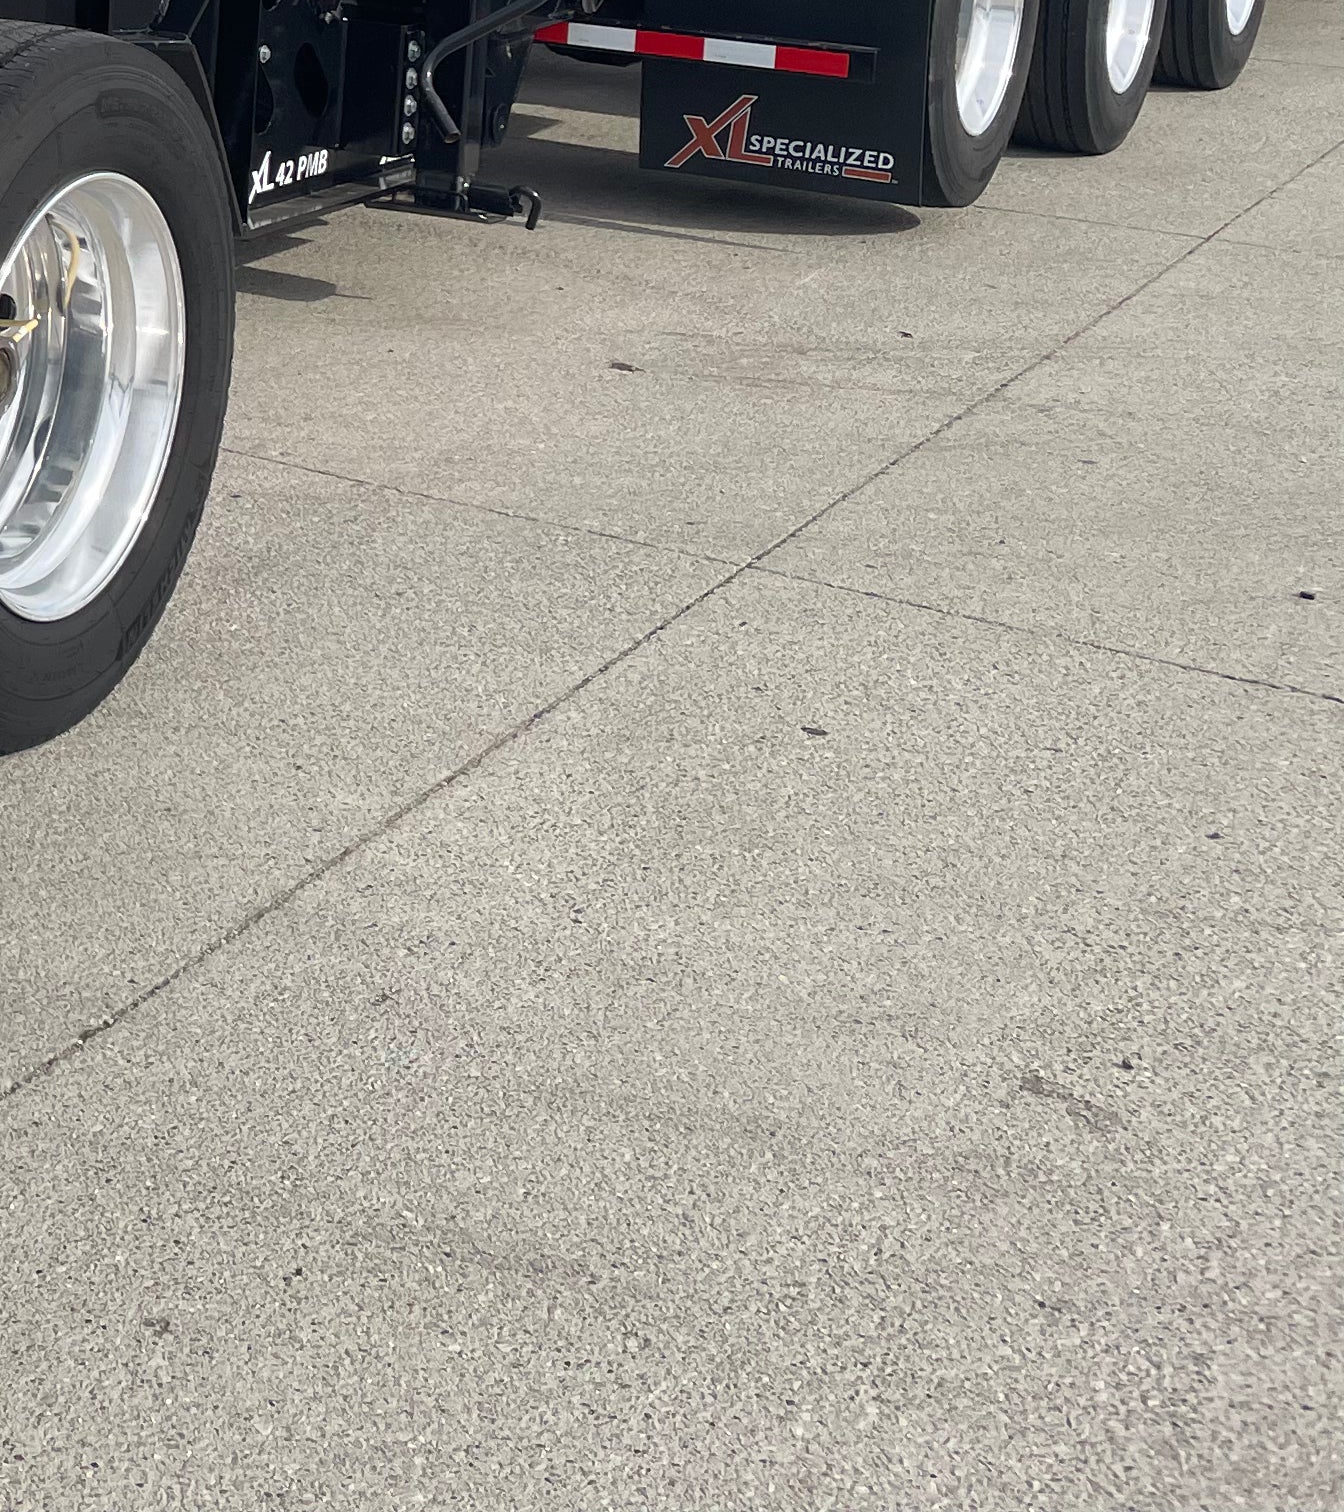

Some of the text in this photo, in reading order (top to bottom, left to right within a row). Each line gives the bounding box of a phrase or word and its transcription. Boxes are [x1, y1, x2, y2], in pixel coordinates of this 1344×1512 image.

[664, 94, 895, 170] XL SPECIALIZED
[248, 149, 329, 205] XL 42 PMB
[776, 156, 840, 177] TRAILERS
